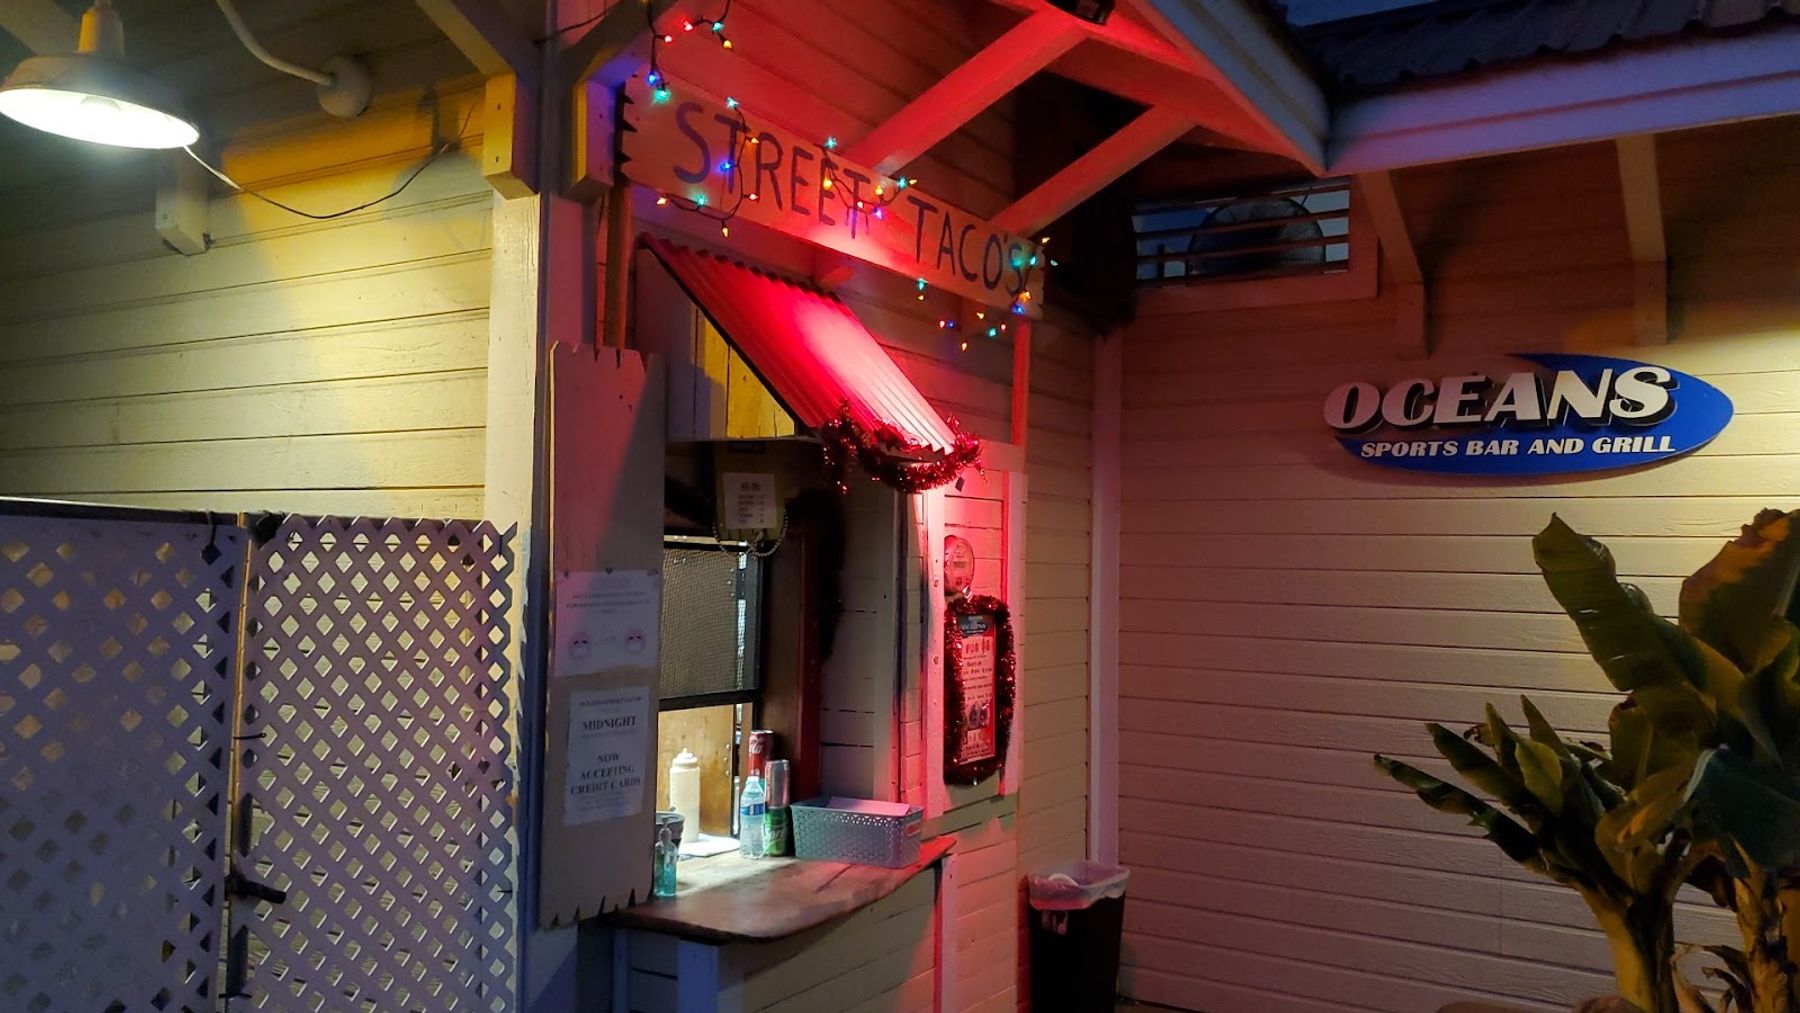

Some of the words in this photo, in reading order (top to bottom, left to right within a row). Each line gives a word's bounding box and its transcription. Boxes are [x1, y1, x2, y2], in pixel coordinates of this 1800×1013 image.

[672, 102, 873, 239] STREET
[1323, 367, 1674, 429] OCEANS
[1361, 440, 1458, 458] SPORTS
[1466, 439, 1520, 457] BAR
[1527, 437, 1585, 455] AND
[1591, 435, 1677, 454] GRILL
[582, 715, 636, 731] MIDNIGHT
[598, 752, 620, 763] NOW
[581, 765, 635, 780] ACCEPTING
[570, 781, 609, 796] CREDIT
[610, 776, 642, 791] CARDS
